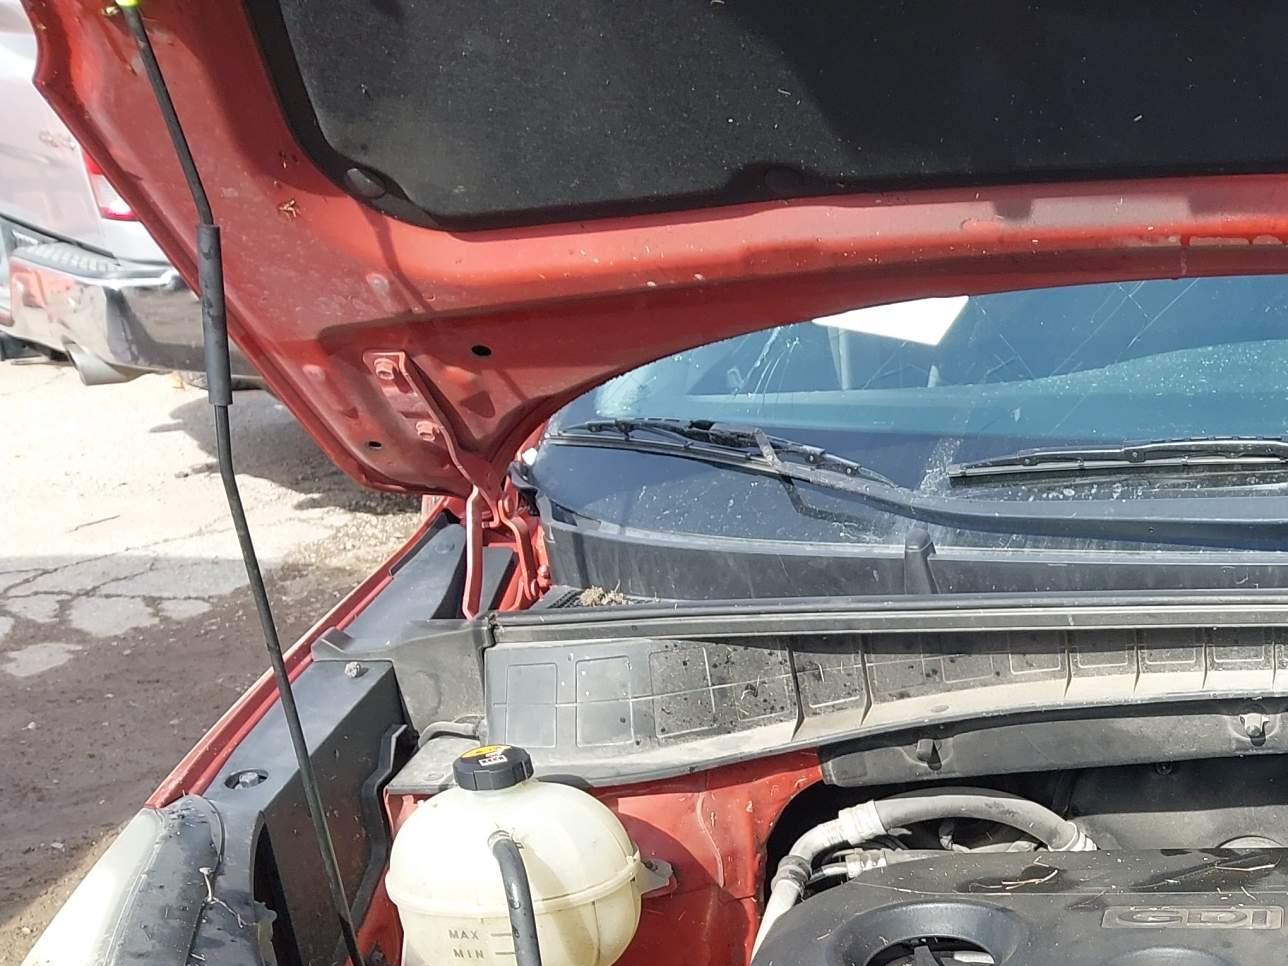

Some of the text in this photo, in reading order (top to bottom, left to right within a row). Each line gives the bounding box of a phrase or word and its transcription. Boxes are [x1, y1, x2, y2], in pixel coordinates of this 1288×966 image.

[1117, 909, 1270, 928] GDI
[449, 929, 479, 940] MAX
[453, 948, 484, 959] MIN
